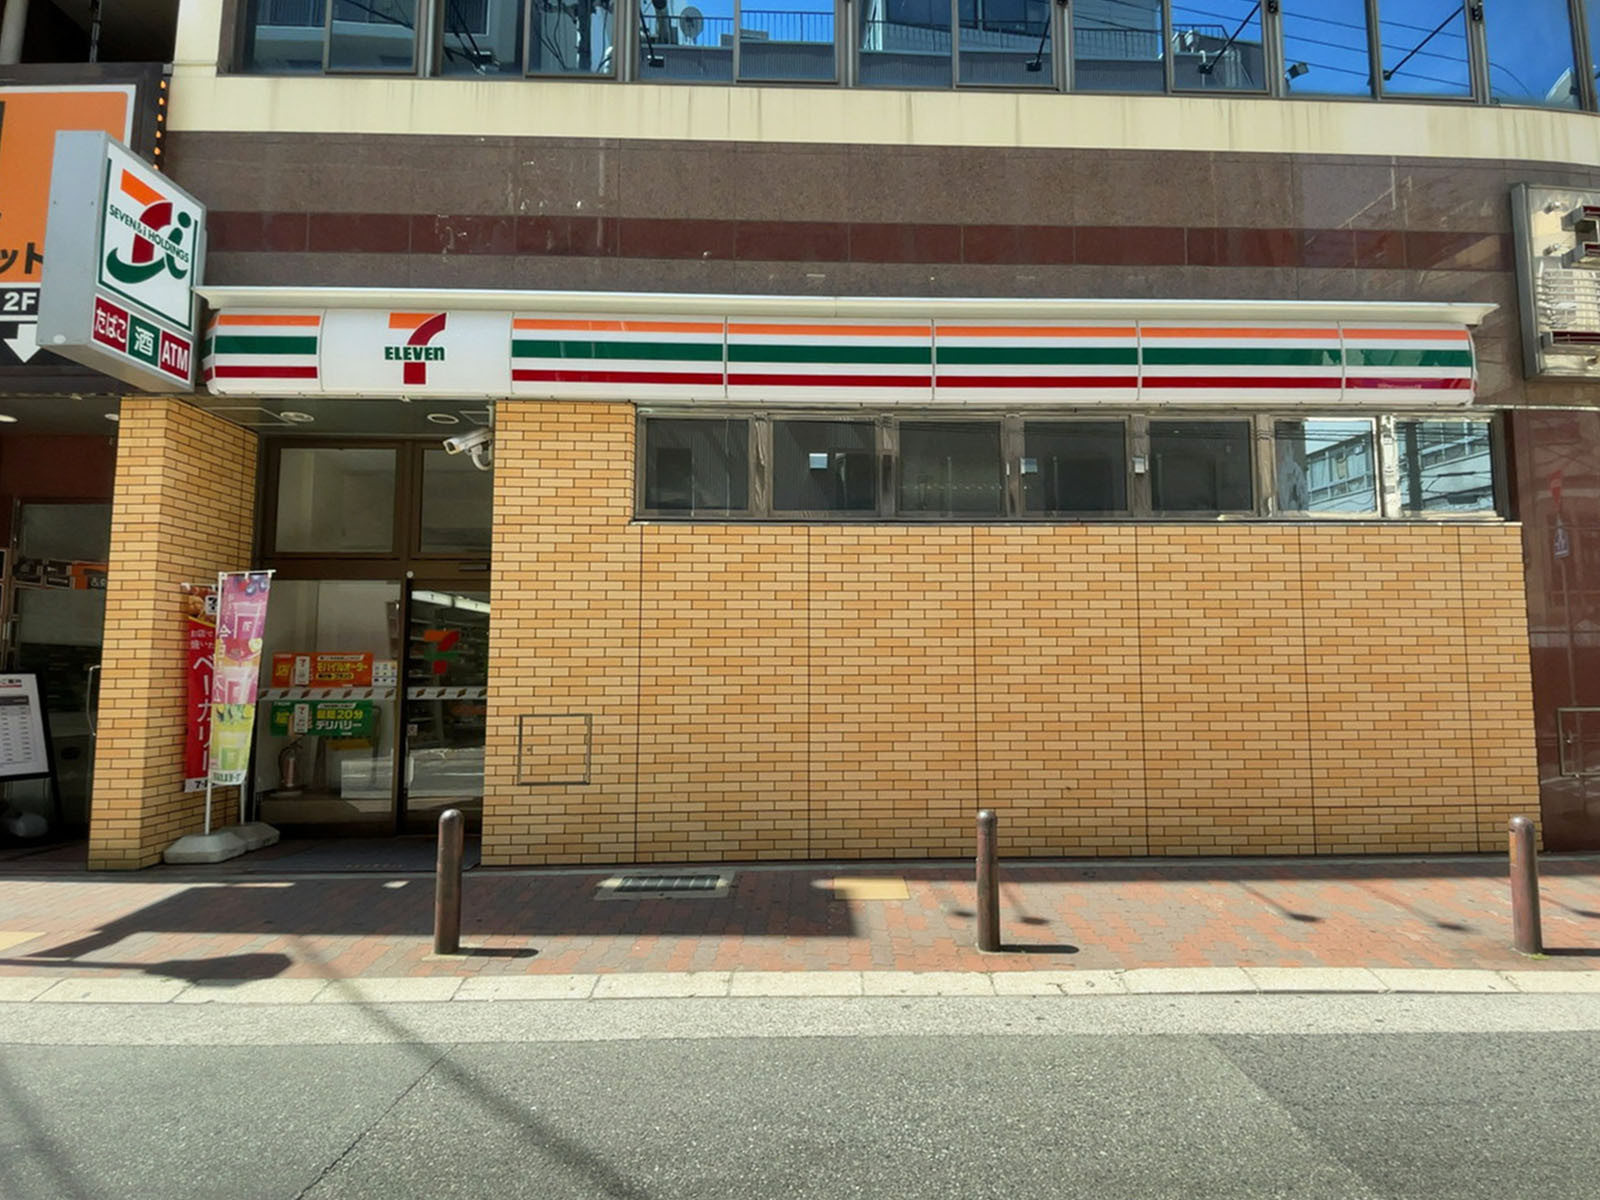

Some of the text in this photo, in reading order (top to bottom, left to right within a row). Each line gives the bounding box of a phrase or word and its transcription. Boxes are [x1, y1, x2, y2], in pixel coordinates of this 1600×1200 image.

[147, 228, 190, 263] HOLDINGS
[3, 291, 37, 312] 2F
[95, 307, 127, 343] たばこ
[134, 326, 155, 356] 酒
[162, 340, 188, 372] ATM
